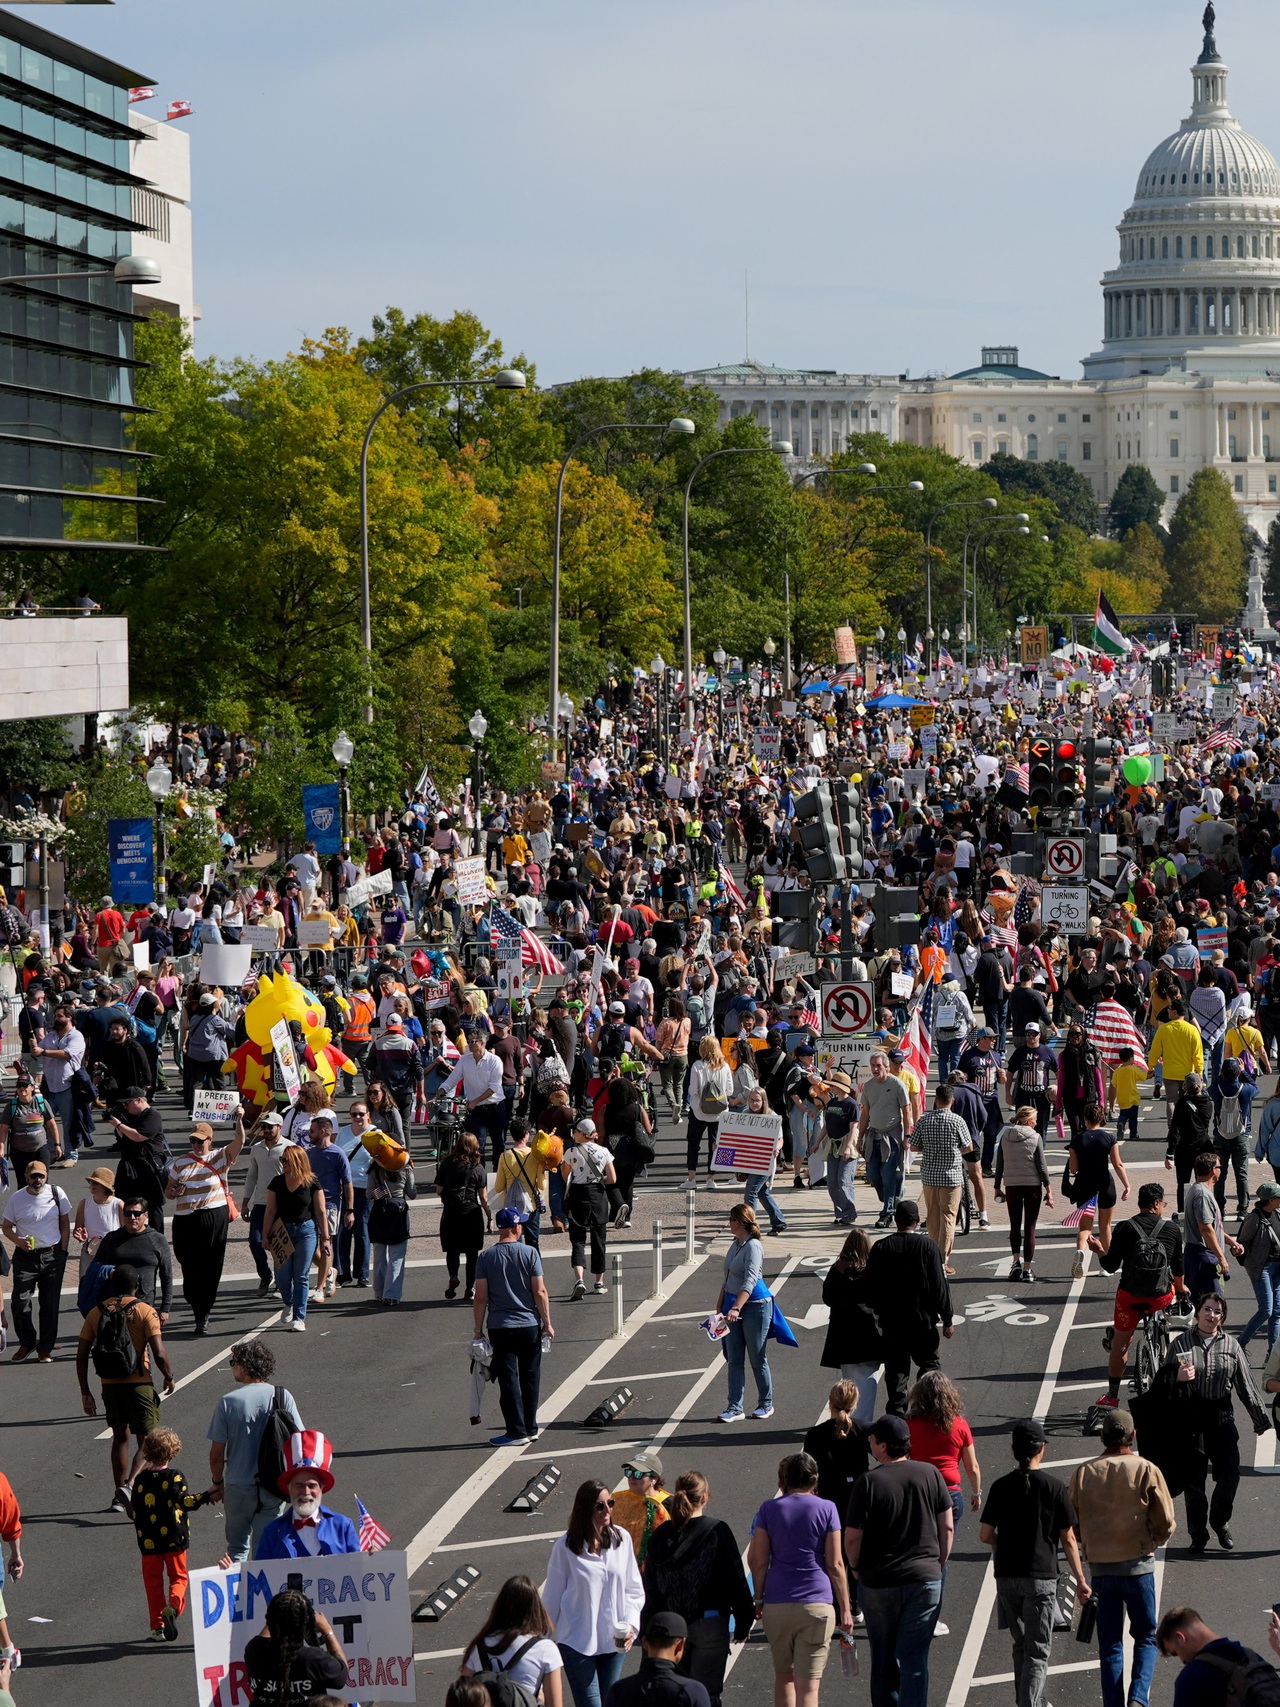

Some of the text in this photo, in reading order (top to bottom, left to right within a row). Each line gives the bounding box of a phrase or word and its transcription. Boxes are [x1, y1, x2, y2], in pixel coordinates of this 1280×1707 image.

[1026, 643, 1041, 655] NO
[759, 735, 778, 744] YOU
[121, 834, 141, 842] WHERE
[117, 842, 146, 850] DISCOVERY
[116, 857, 147, 865] DEMOCRACY
[1051, 892, 1079, 900] TURNING
[497, 938, 511, 948] SAME
[495, 948, 520, 960] DIFFERENT
[927, 954, 938, 965] 19
[785, 962, 814, 975] PEOPLE
[428, 990, 449, 1000] SALE
[828, 1042, 871, 1052] TURNING
[1020, 1084, 1045, 1092] KINGS
[204, 1092, 234, 1101] PREFER
[215, 1102, 230, 1111] ICE
[722, 1114, 780, 1130] WE ARE NOT OKAY
[277, 1225, 289, 1244] NO
[268, 1230, 288, 1265] KINGS
